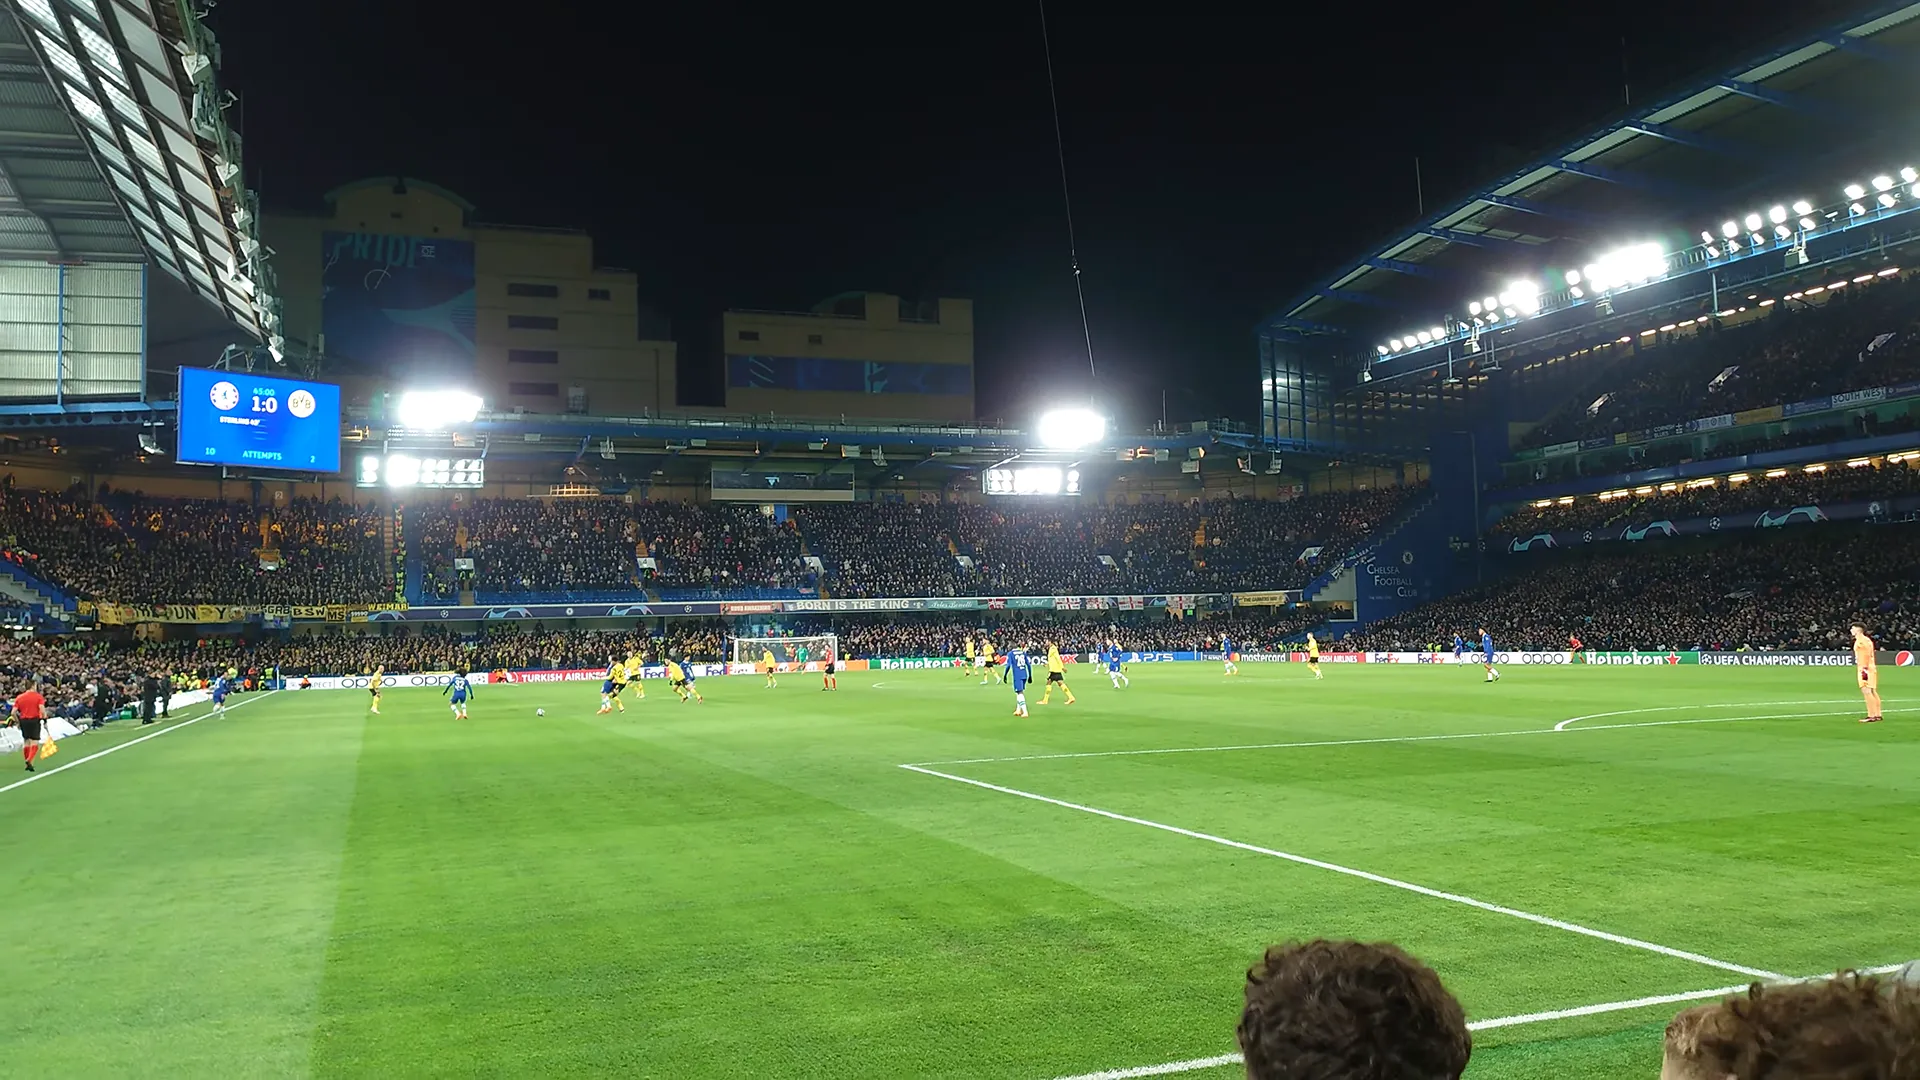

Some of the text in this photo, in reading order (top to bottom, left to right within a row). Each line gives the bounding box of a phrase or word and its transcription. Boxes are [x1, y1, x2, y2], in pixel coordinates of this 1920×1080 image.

[253, 387, 275, 396] 45:00
[1832, 391, 1861, 404] SOUTH
[251, 396, 278, 413] 1:0
[205, 447, 216, 455] 10
[242, 450, 282, 461] ATTEMPTS
[1366, 563, 1401, 575] CHELSEA
[1374, 575, 1413, 587] FOOTBALL
[1397, 586, 1418, 597] CLUB
[368, 603, 408, 611] WEIMAR
[796, 600, 909, 611] BORN IS THE KING
[1143, 653, 1174, 662] PS5
[1241, 653, 1286, 662] mastercard
[1375, 653, 1400, 664] FedEx
[1417, 653, 1445, 664] FedEx
[1522, 653, 1564, 665] oppo
[1584, 652, 1664, 665] Heineken
[1713, 655, 1853, 666] UEFA CHAMPIONS LEAGUE
[880, 658, 950, 671] Heineken
[411, 675, 451, 687] opp
[521, 673, 563, 683] TURKISH
